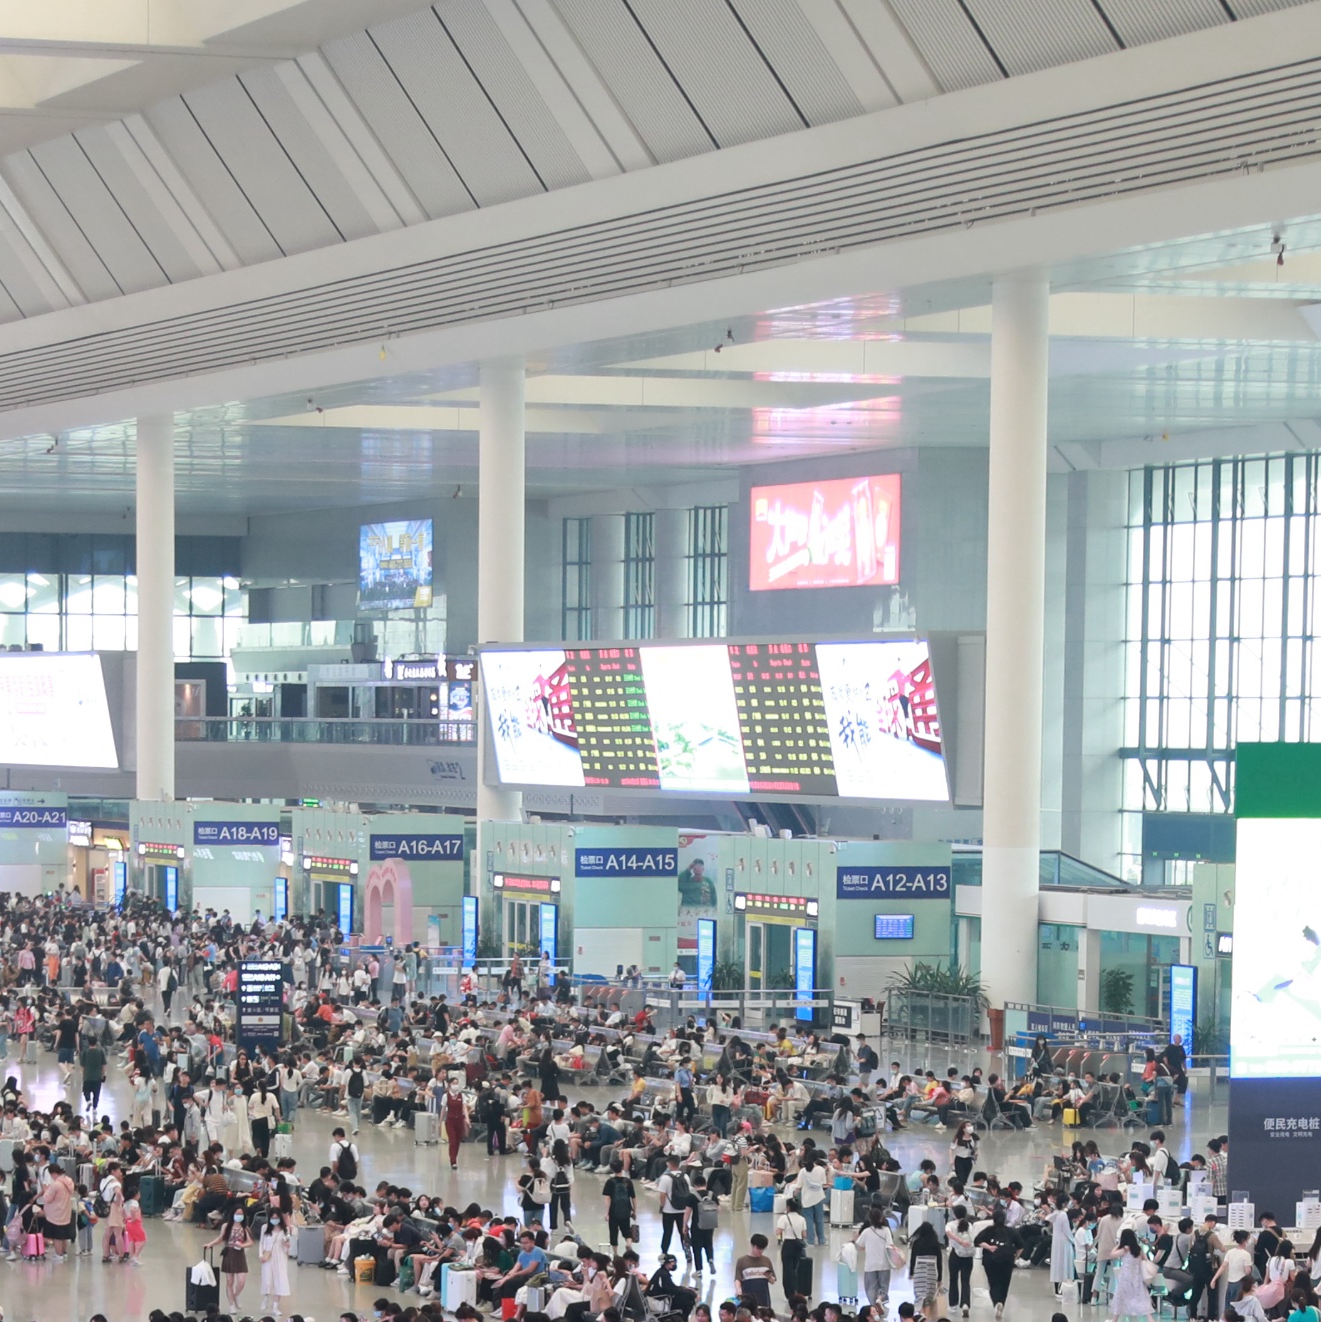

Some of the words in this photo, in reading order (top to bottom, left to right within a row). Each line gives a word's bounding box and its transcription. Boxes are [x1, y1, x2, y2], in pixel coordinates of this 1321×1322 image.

[12, 811, 66, 823] A20-A21
[198, 827, 218, 835] 检票口
[219, 826, 278, 840] A18-A19
[374, 840, 396, 849] 检票口
[397, 840, 461, 854] A16-A17
[580, 855, 604, 865] 检票口
[606, 854, 675, 870] A14-A15
[842, 875, 869, 885] 检票口
[871, 873, 948, 892] A12-A13
[1263, 1117, 1321, 1131] 便民充电桩
